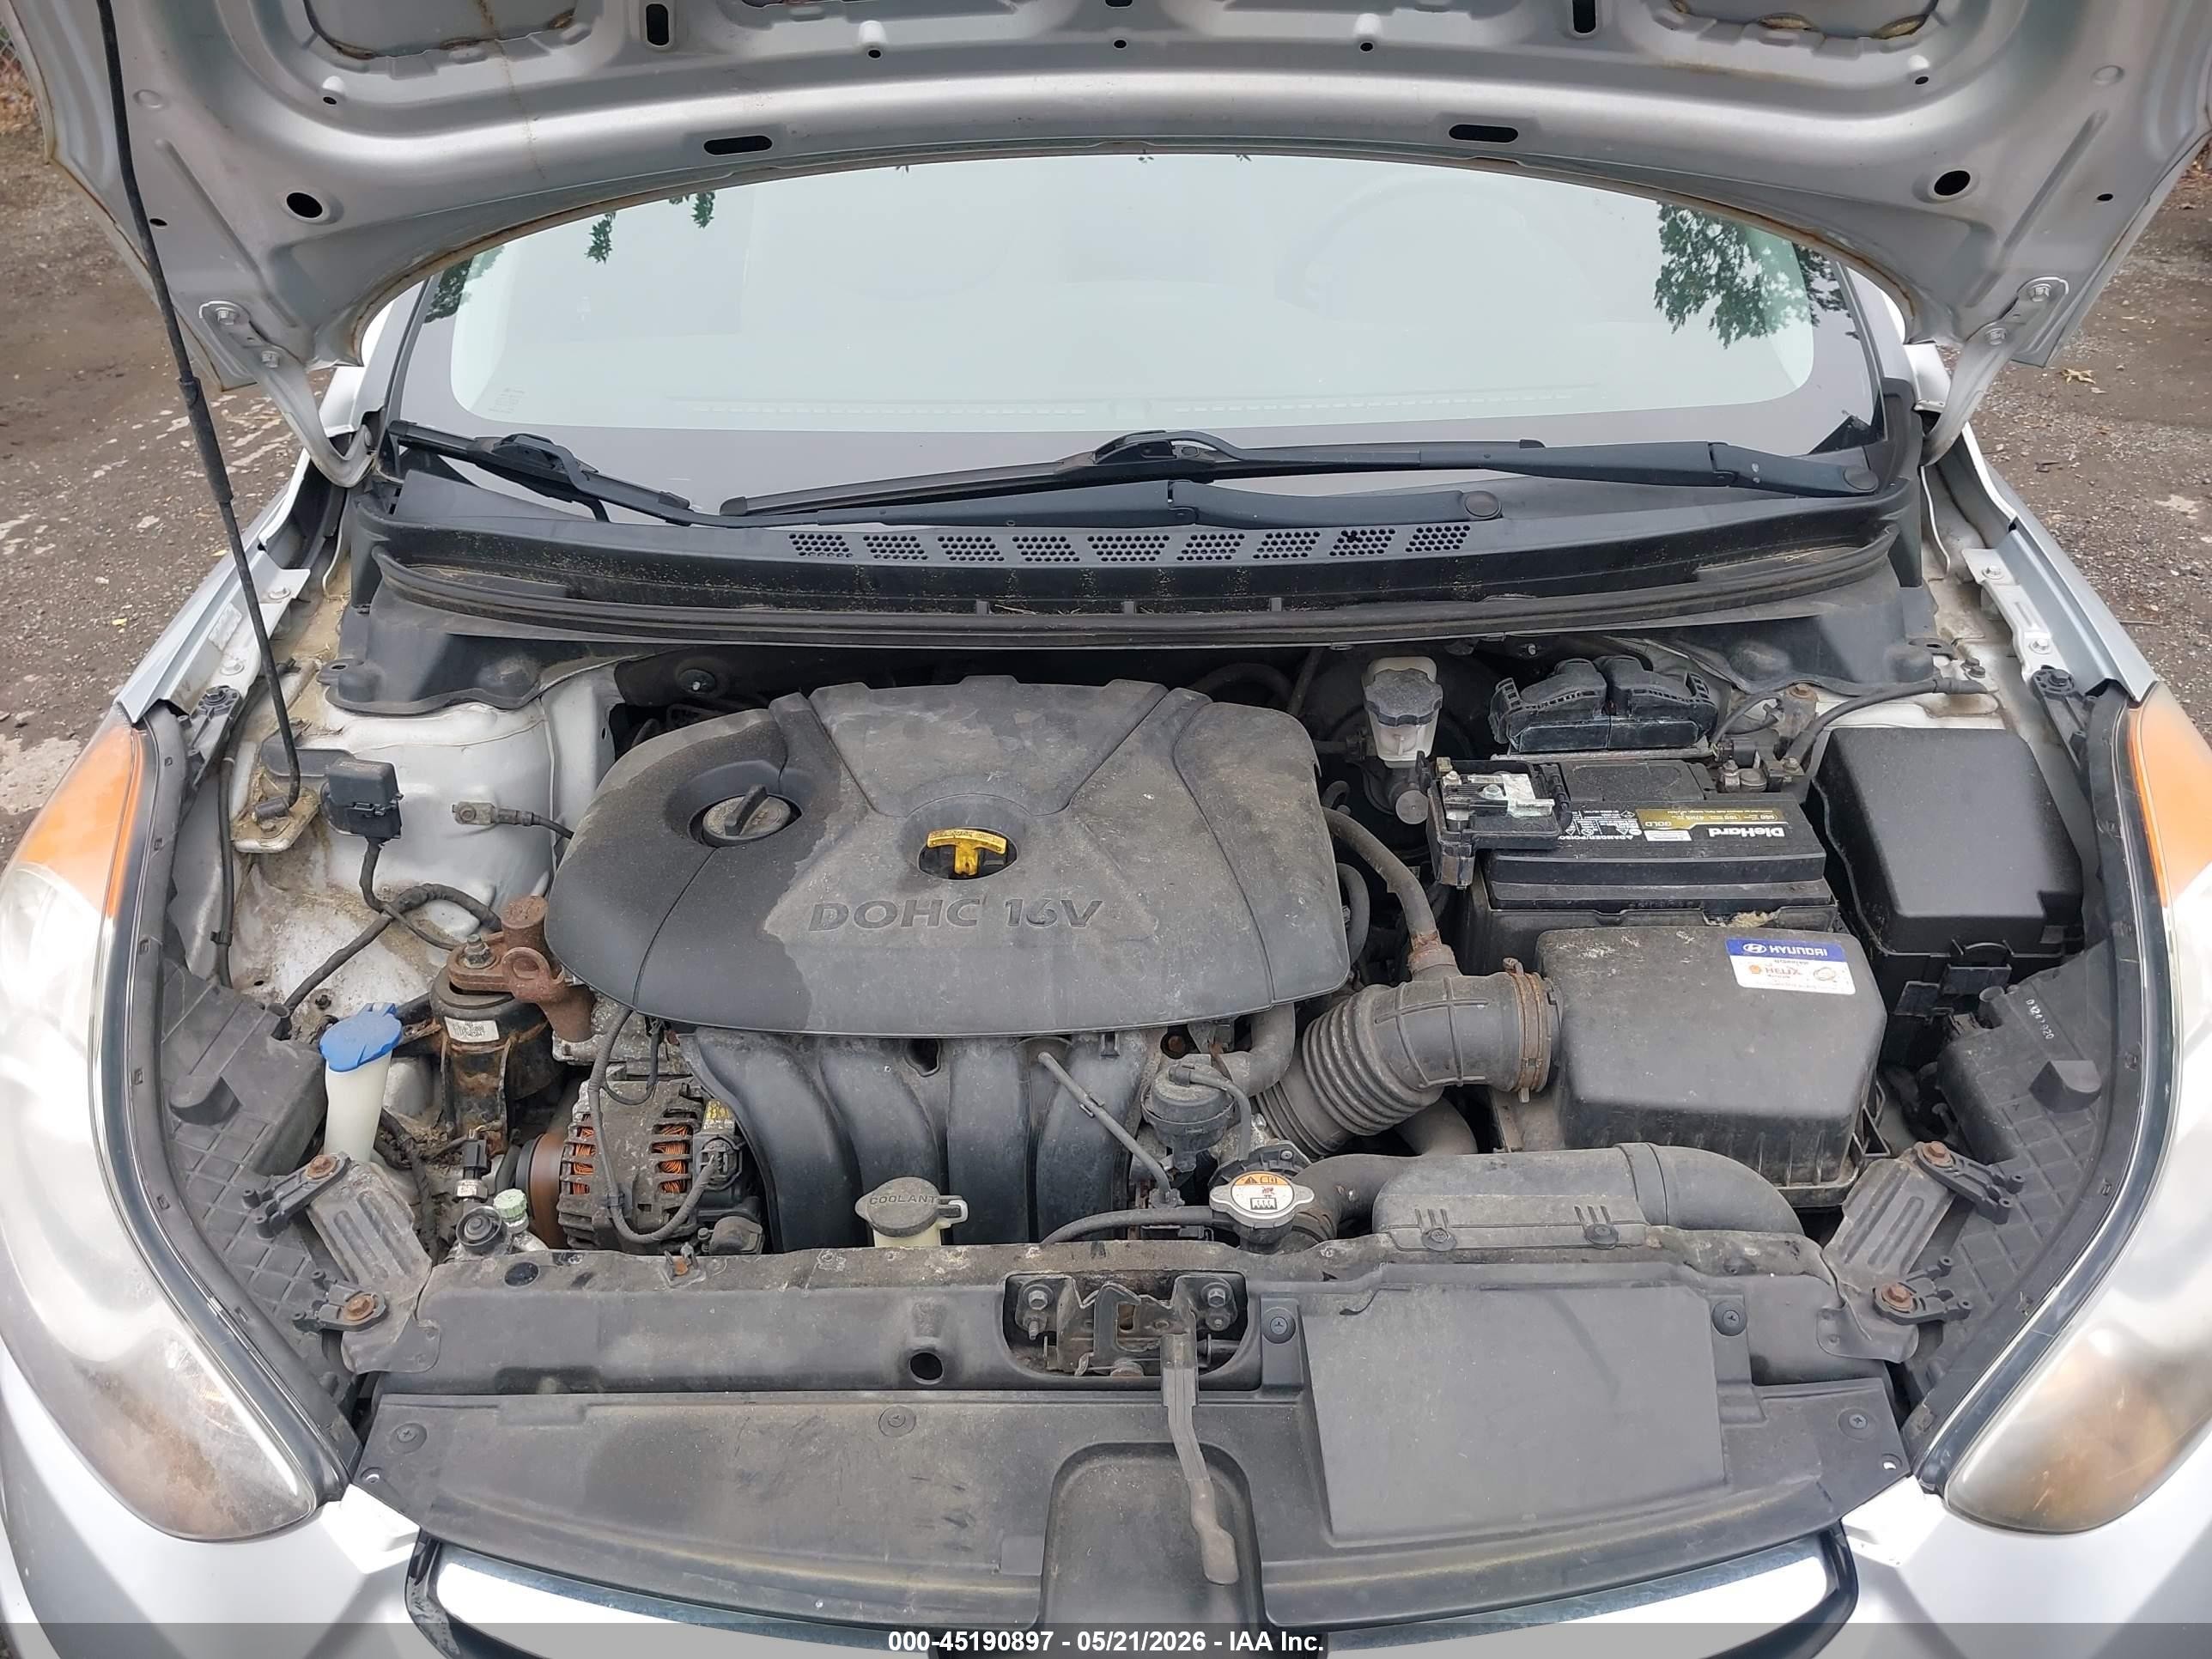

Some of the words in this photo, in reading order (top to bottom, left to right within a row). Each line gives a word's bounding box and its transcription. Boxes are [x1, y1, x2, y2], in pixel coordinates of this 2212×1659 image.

[1708, 827, 1786, 838] DieHard
[809, 899, 981, 932] DOHC
[1004, 899, 1103, 927] 16V
[1769, 945, 1828, 957] HYUNDAI
[869, 1194, 938, 1205] COOLANT
